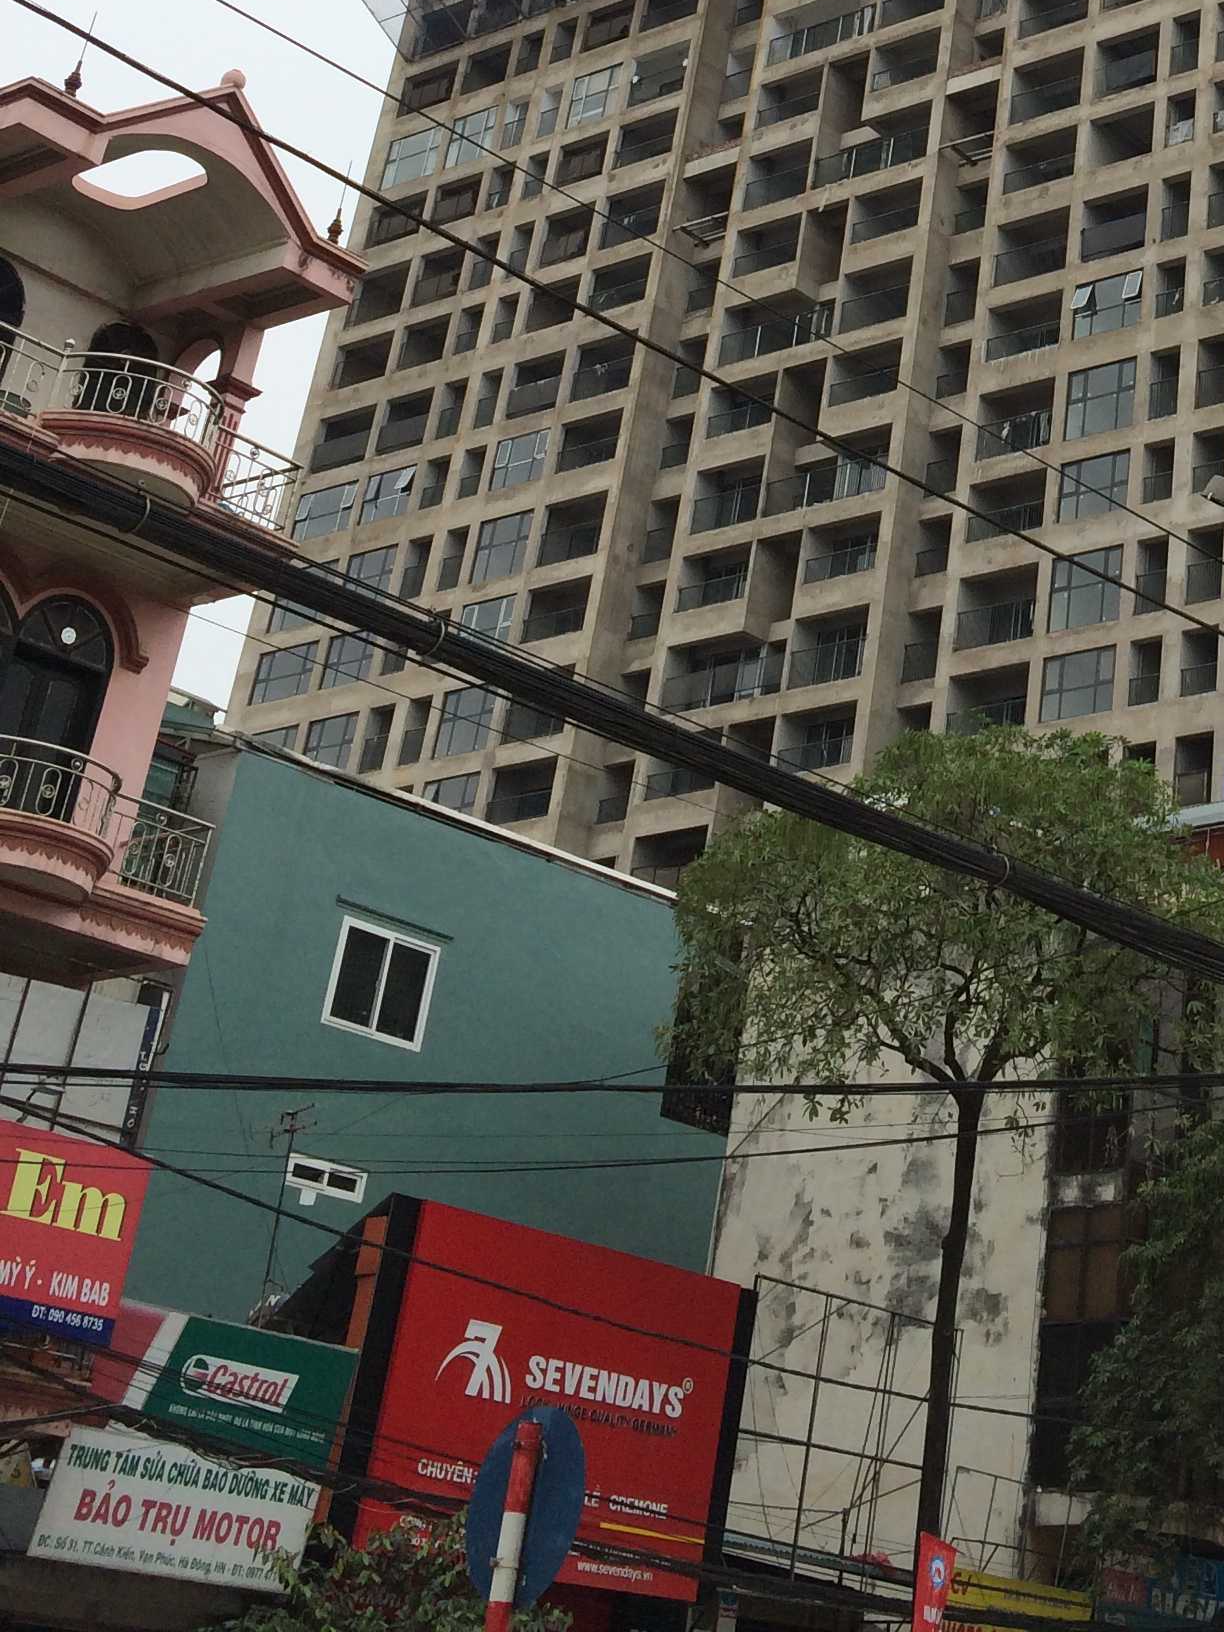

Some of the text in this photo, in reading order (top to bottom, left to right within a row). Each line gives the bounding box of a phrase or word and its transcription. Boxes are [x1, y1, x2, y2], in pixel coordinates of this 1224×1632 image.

[0, 1147, 127, 1242] Em
[49, 1270, 78, 1301] KIM
[80, 1278, 111, 1308] BAB
[207, 1364, 289, 1409] Castrol
[67, 1443, 111, 1473] TRUNG
[270, 1482, 287, 1505] XE
[73, 1479, 282, 1552] BẢO TRỤ MOTOR
